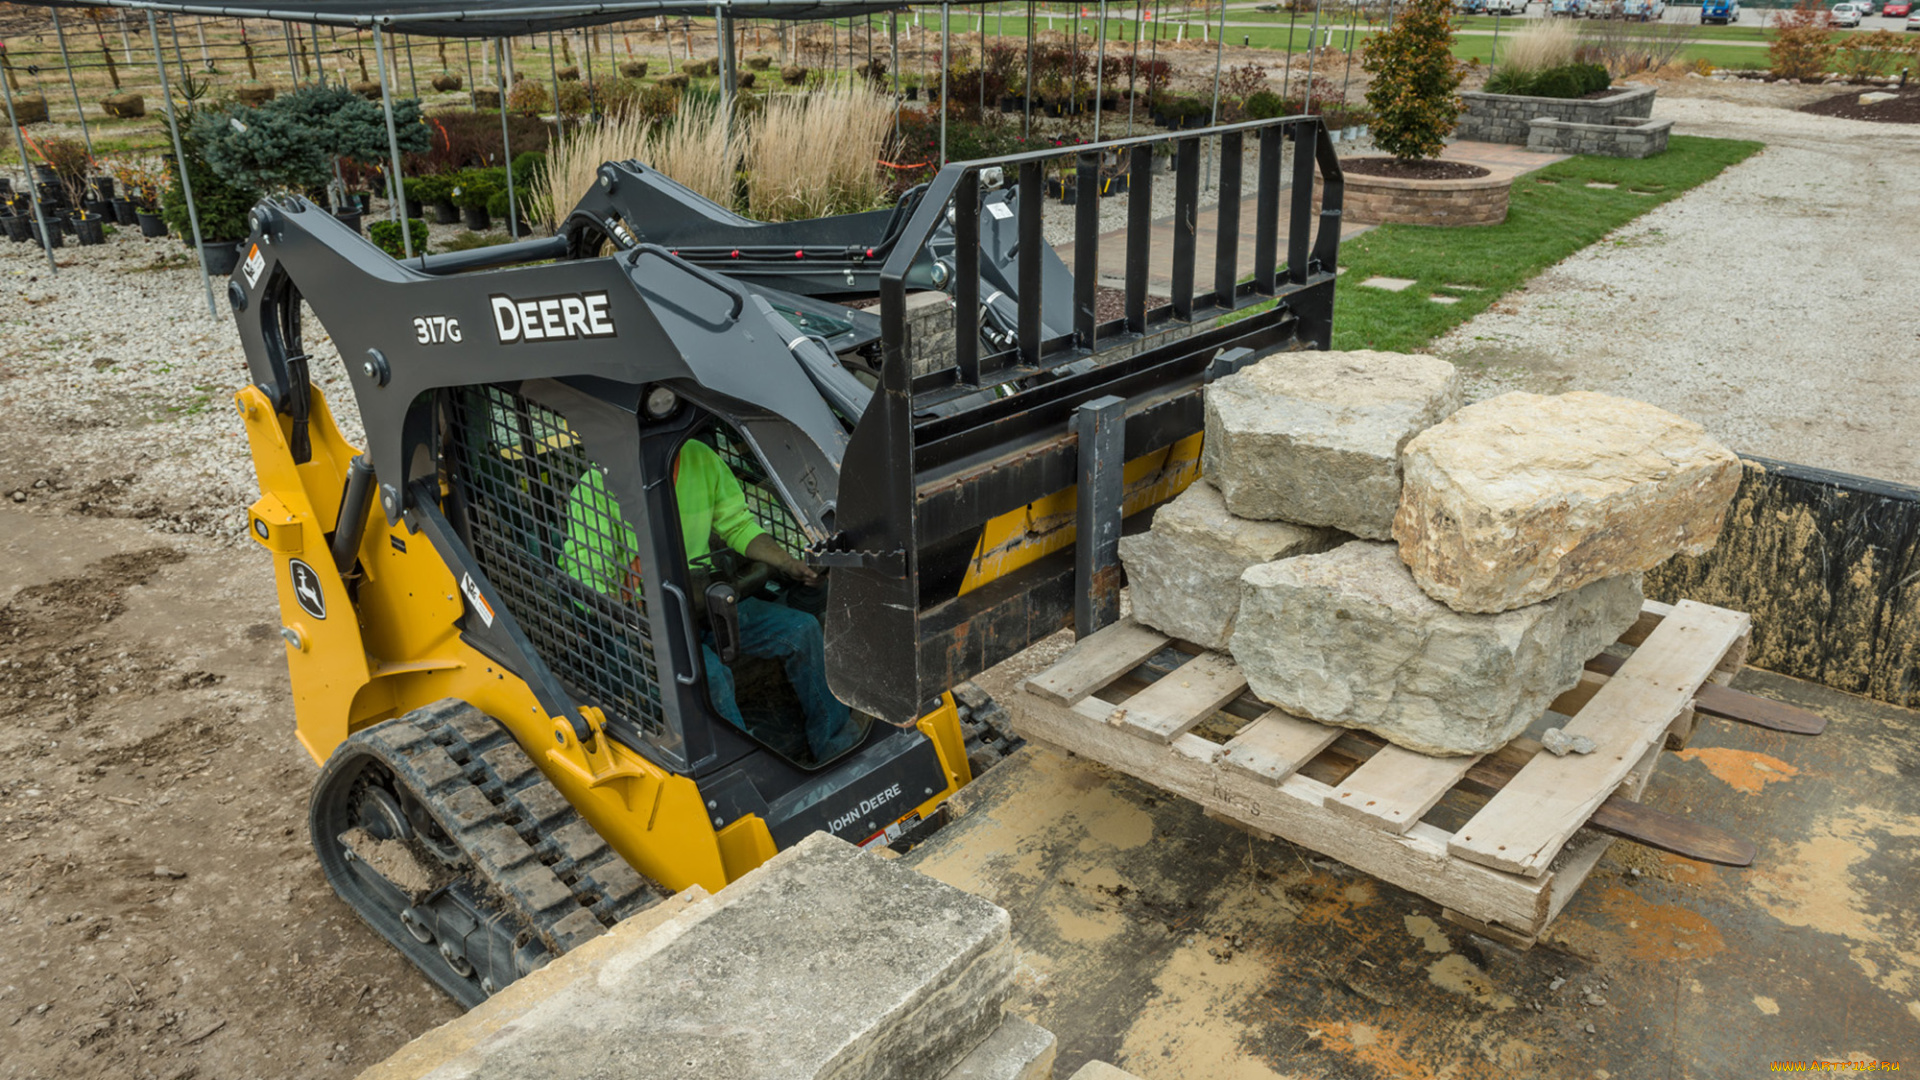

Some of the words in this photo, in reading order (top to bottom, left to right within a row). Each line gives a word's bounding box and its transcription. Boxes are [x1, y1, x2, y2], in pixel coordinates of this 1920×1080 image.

[413, 316, 463, 344] 317G
[490, 293, 615, 341] DEERE
[827, 808, 861, 835] JOHN
[859, 783, 902, 815] DEERE
